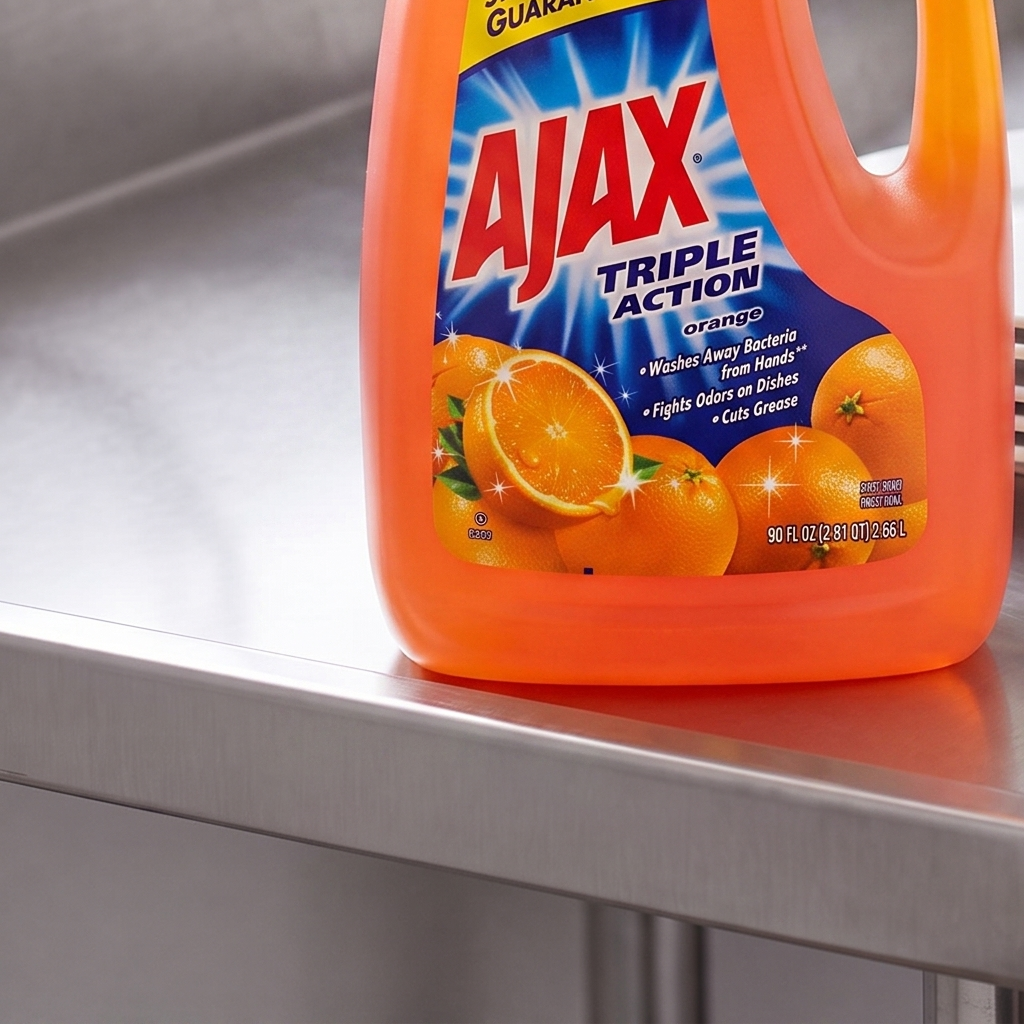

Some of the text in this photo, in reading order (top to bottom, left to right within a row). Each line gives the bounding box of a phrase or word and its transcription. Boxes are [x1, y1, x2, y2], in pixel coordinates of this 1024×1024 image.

[597, 230, 759, 294] TRIPLE
[612, 264, 760, 320] ACTION
[683, 307, 762, 336] orange
[648, 328, 797, 378] Washes Away Bacteria
[721, 362, 751, 381] from
[652, 371, 799, 421] Fights Odors on Dishes
[721, 395, 799, 425] Cuts Grease
[767, 527, 783, 543] 90
[786, 526, 798, 542] FL
[801, 525, 816, 542] OZ
[851, 522, 869, 542] QT)
[872, 521, 897, 539] 2.66
[899, 521, 906, 537] L
